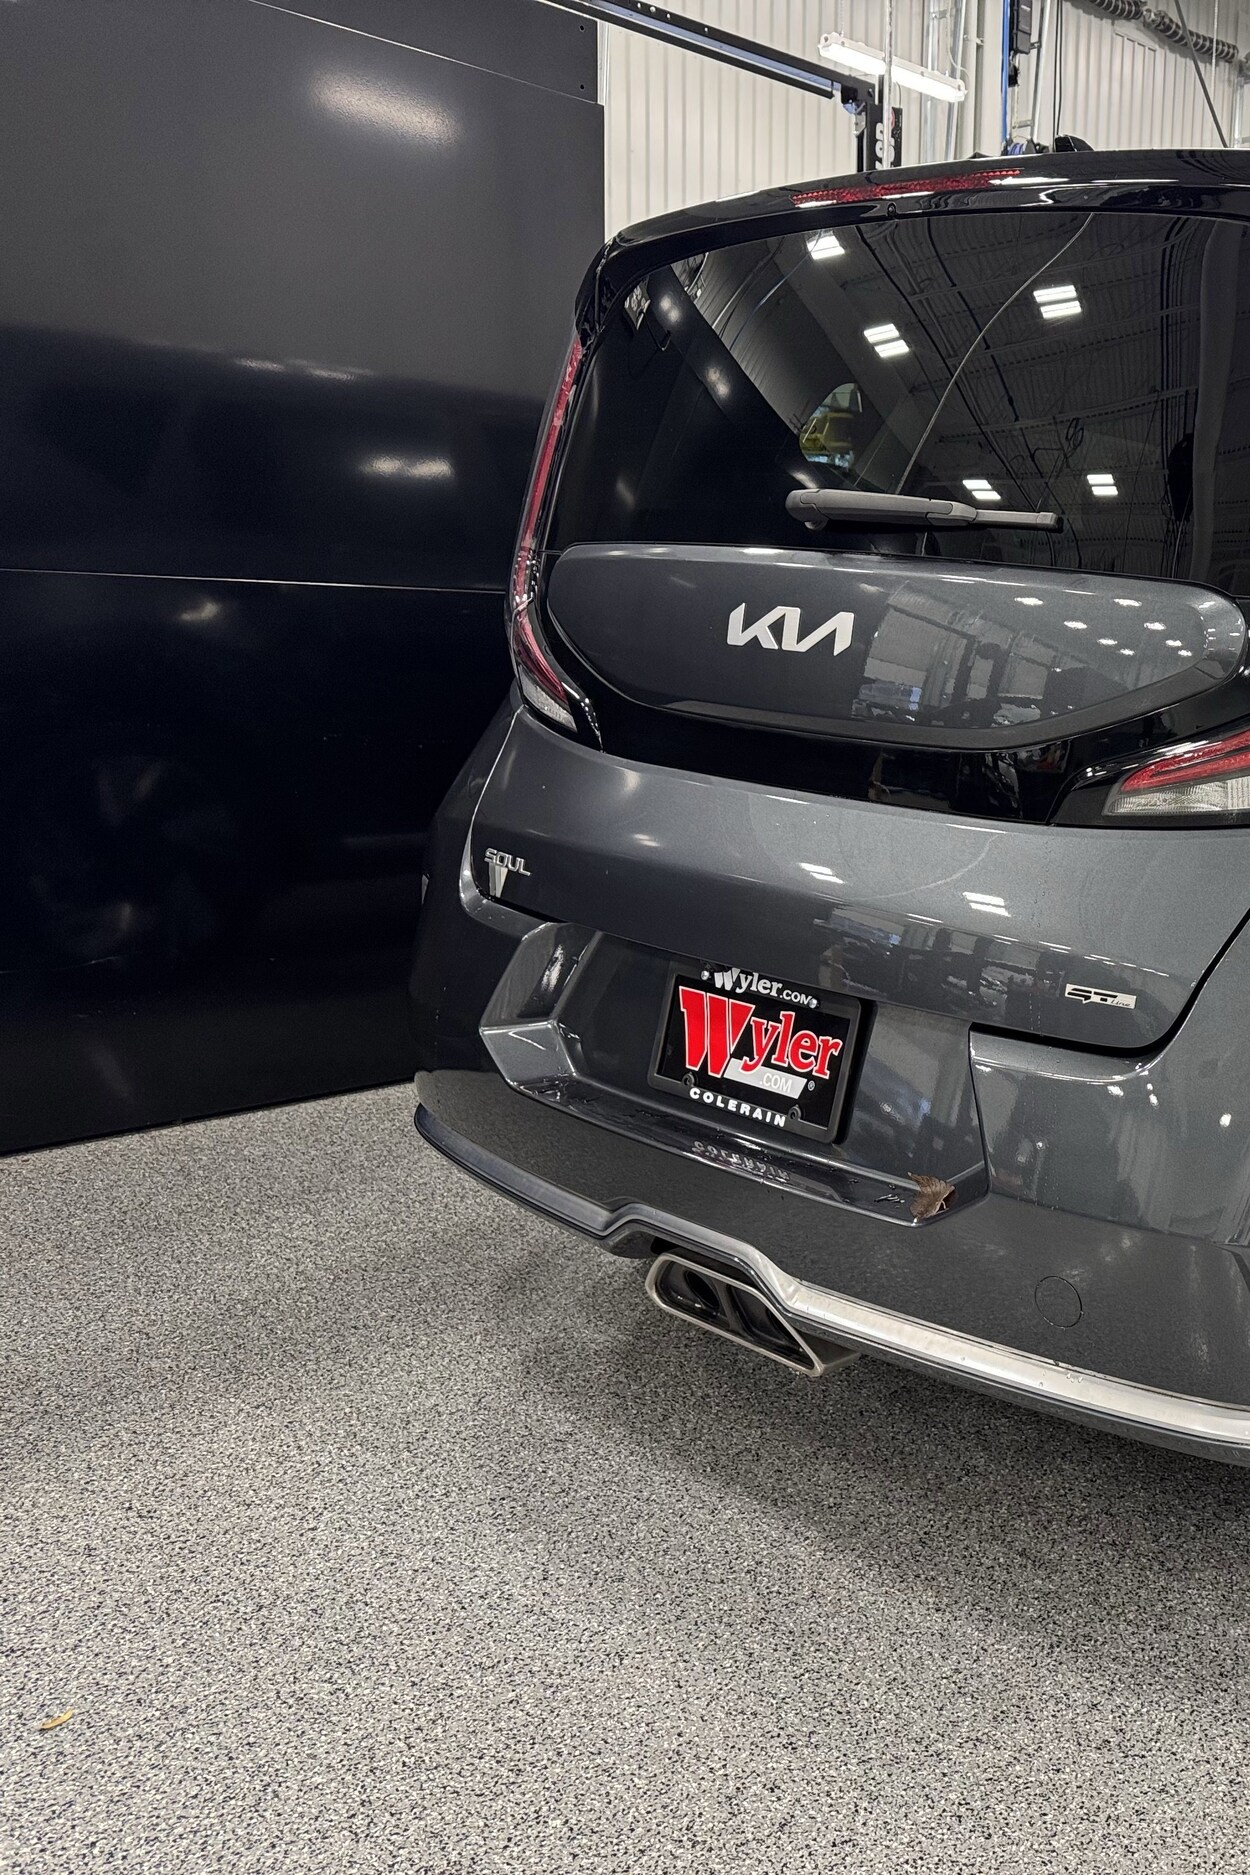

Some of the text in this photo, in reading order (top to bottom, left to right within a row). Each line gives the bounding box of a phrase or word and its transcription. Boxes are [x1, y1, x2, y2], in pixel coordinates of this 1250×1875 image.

[727, 602, 855, 656] KIA
[484, 848, 531, 876] SOUL
[679, 986, 843, 1079] Wyler
[689, 1087, 787, 1127] COLERAIN
